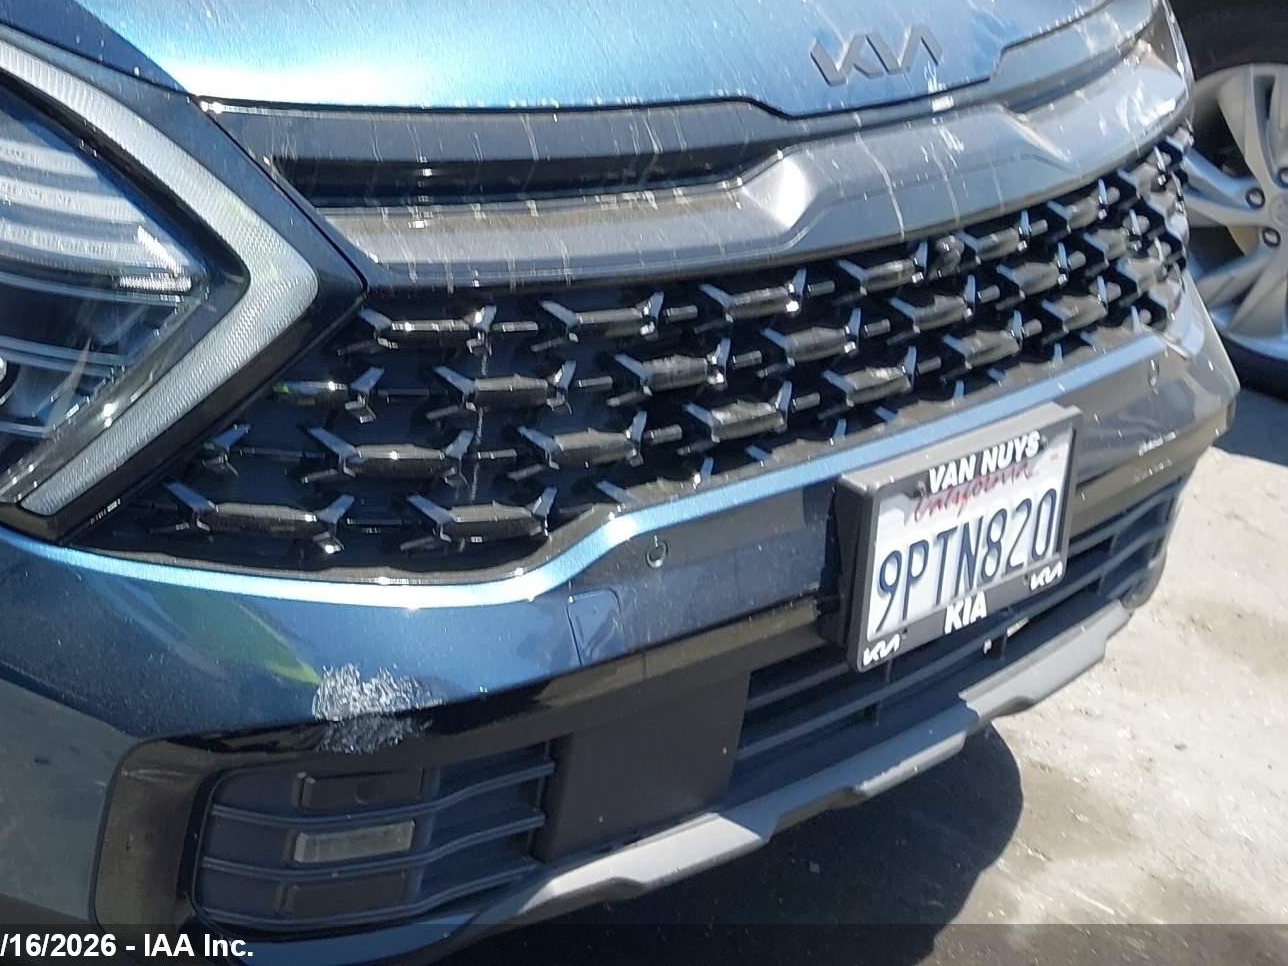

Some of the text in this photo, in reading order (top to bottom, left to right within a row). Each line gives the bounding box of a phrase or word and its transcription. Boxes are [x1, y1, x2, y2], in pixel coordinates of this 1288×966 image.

[928, 430, 1041, 494] VAN NUYS
[874, 487, 1058, 635] 9PTN820
[943, 591, 988, 635] KIA
